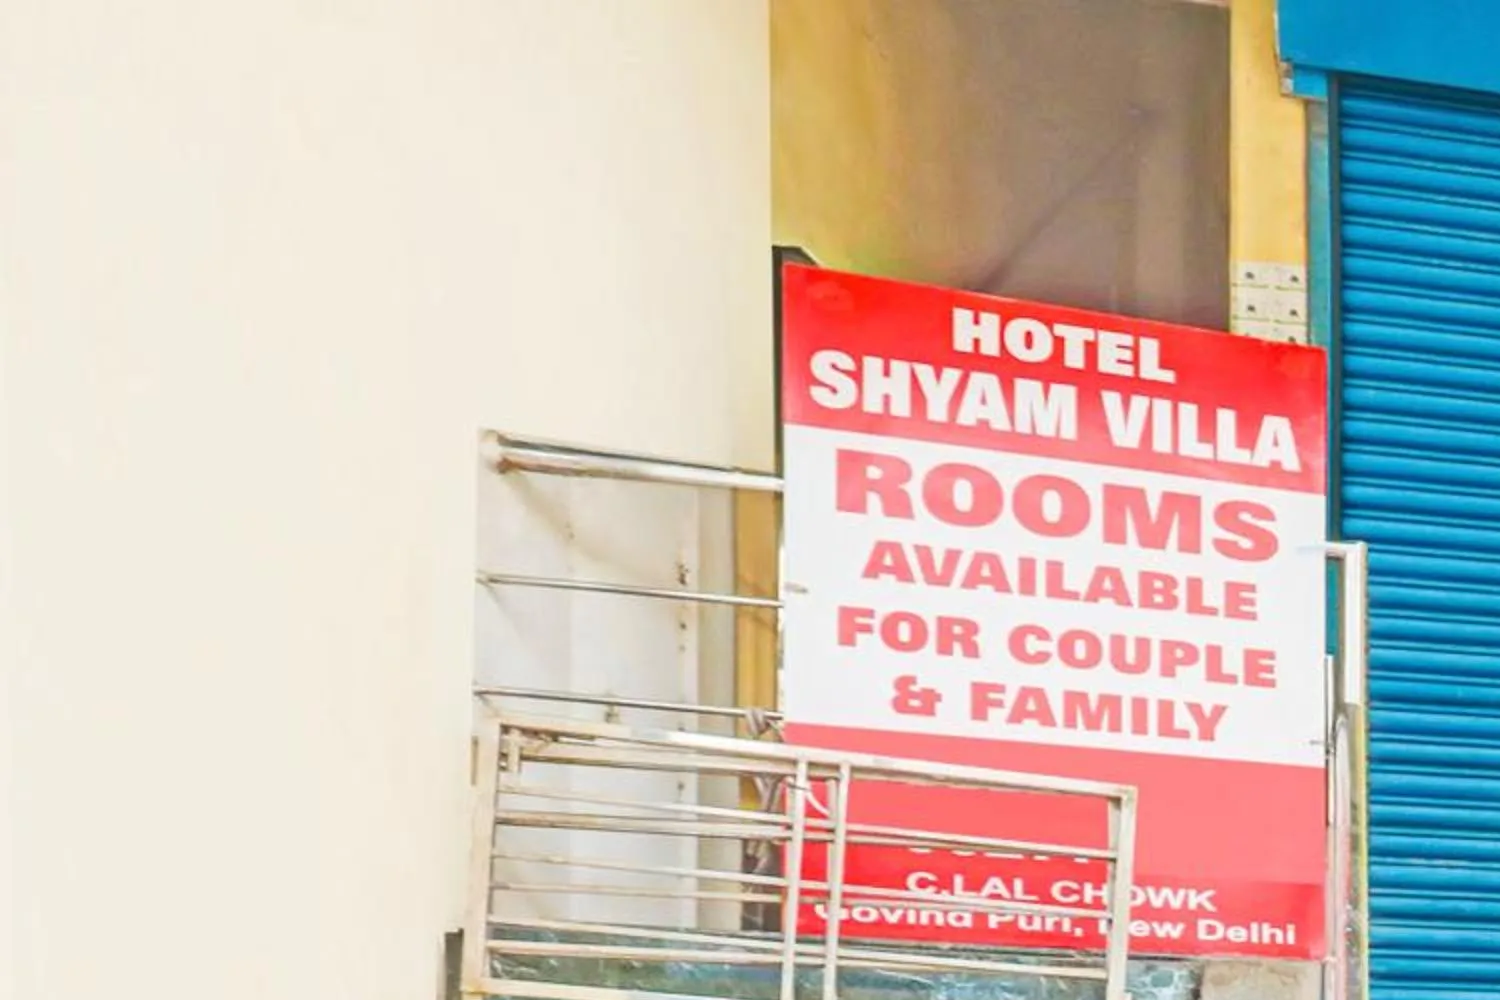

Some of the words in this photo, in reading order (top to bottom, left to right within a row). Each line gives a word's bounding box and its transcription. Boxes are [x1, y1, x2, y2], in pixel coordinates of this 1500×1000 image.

[952, 307, 1176, 384] HOTEL
[809, 350, 1077, 442] SHYAM
[1102, 390, 1301, 472] VILLA
[835, 448, 1279, 563] ROOMS
[861, 541, 1258, 621] AVAILABLE
[837, 606, 981, 659] FOR
[1007, 625, 1277, 688] COUPLE
[892, 675, 942, 717] &
[969, 683, 1229, 742] FAMILY
[1198, 918, 1296, 945] Delhi
